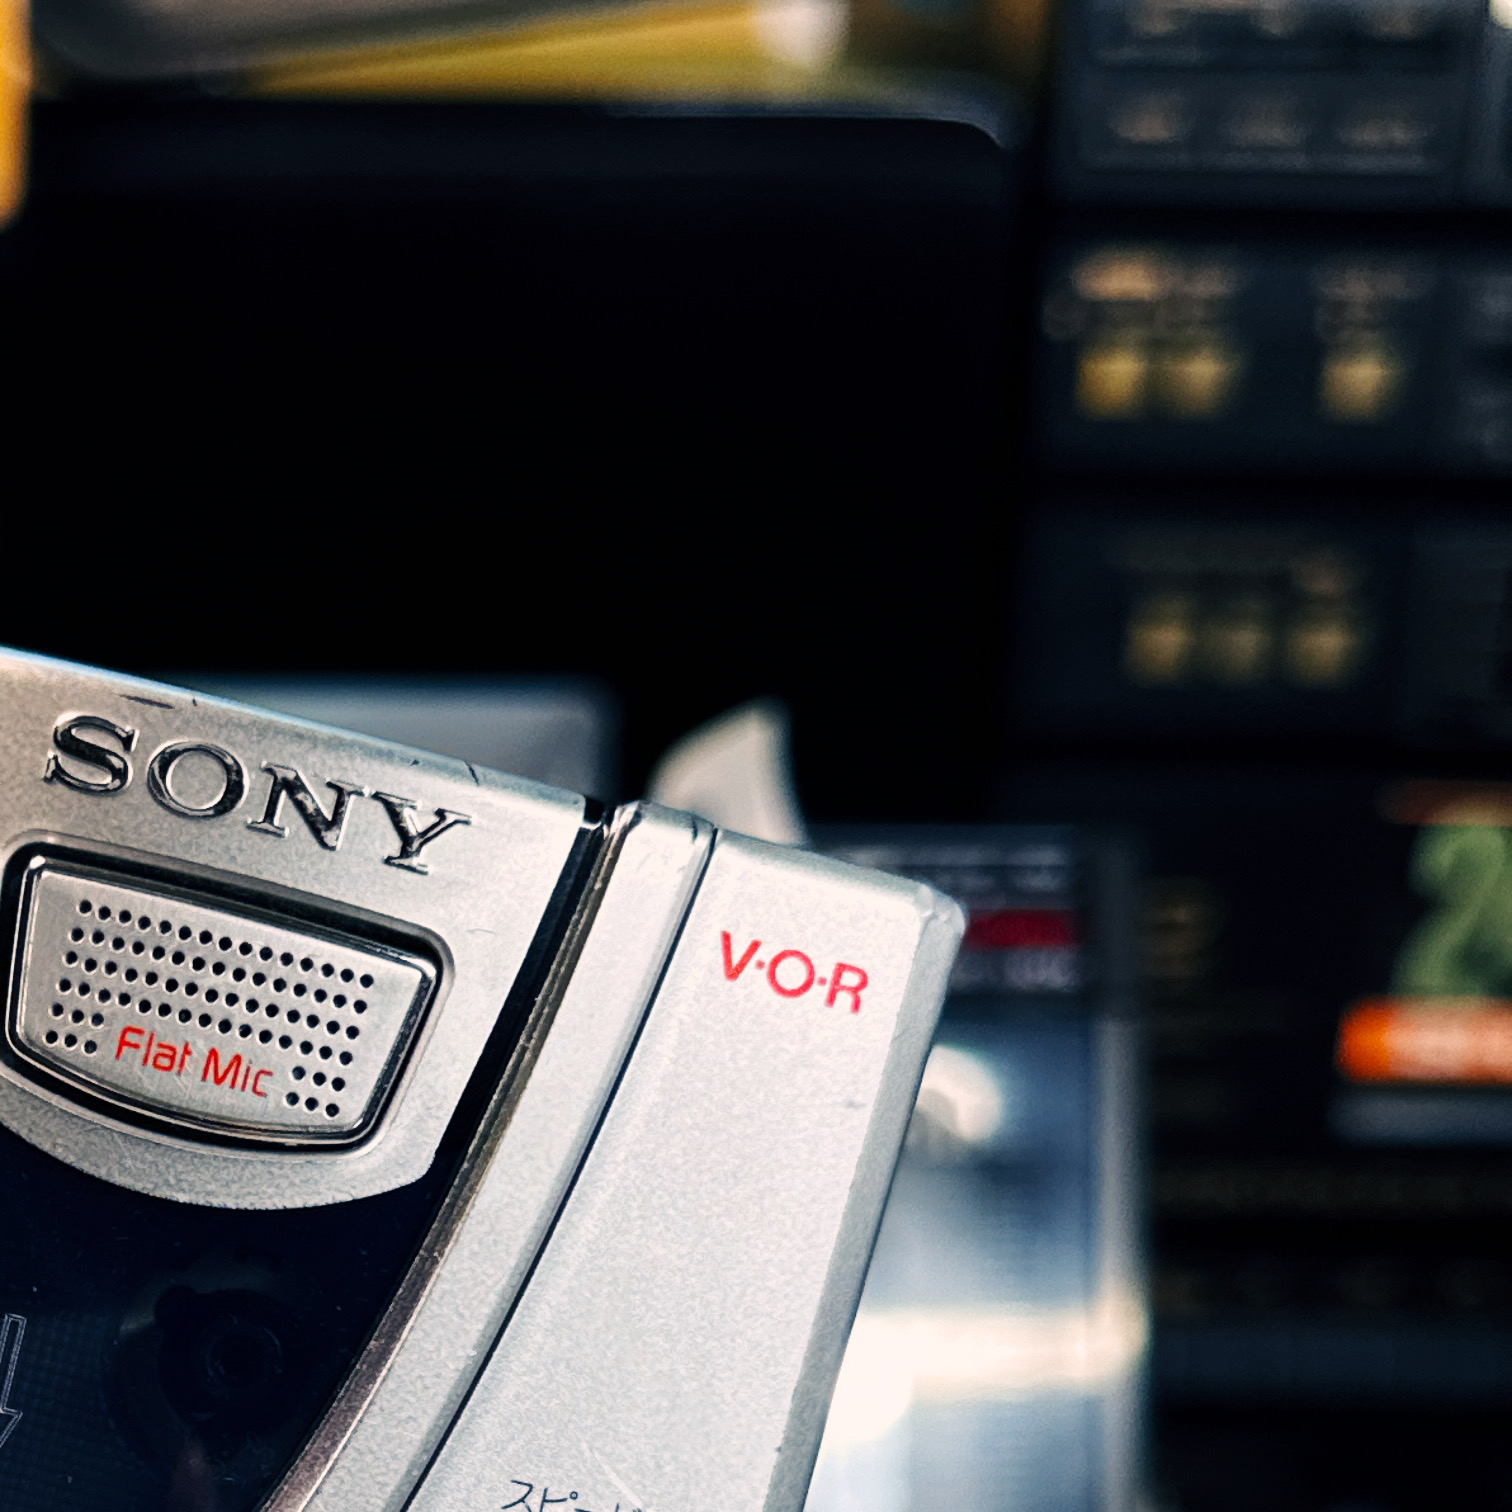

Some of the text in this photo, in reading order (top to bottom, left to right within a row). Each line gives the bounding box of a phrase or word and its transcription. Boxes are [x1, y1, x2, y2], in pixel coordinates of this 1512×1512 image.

[42, 714, 473, 876] SONY
[114, 1026, 274, 1098] Flat Mic
